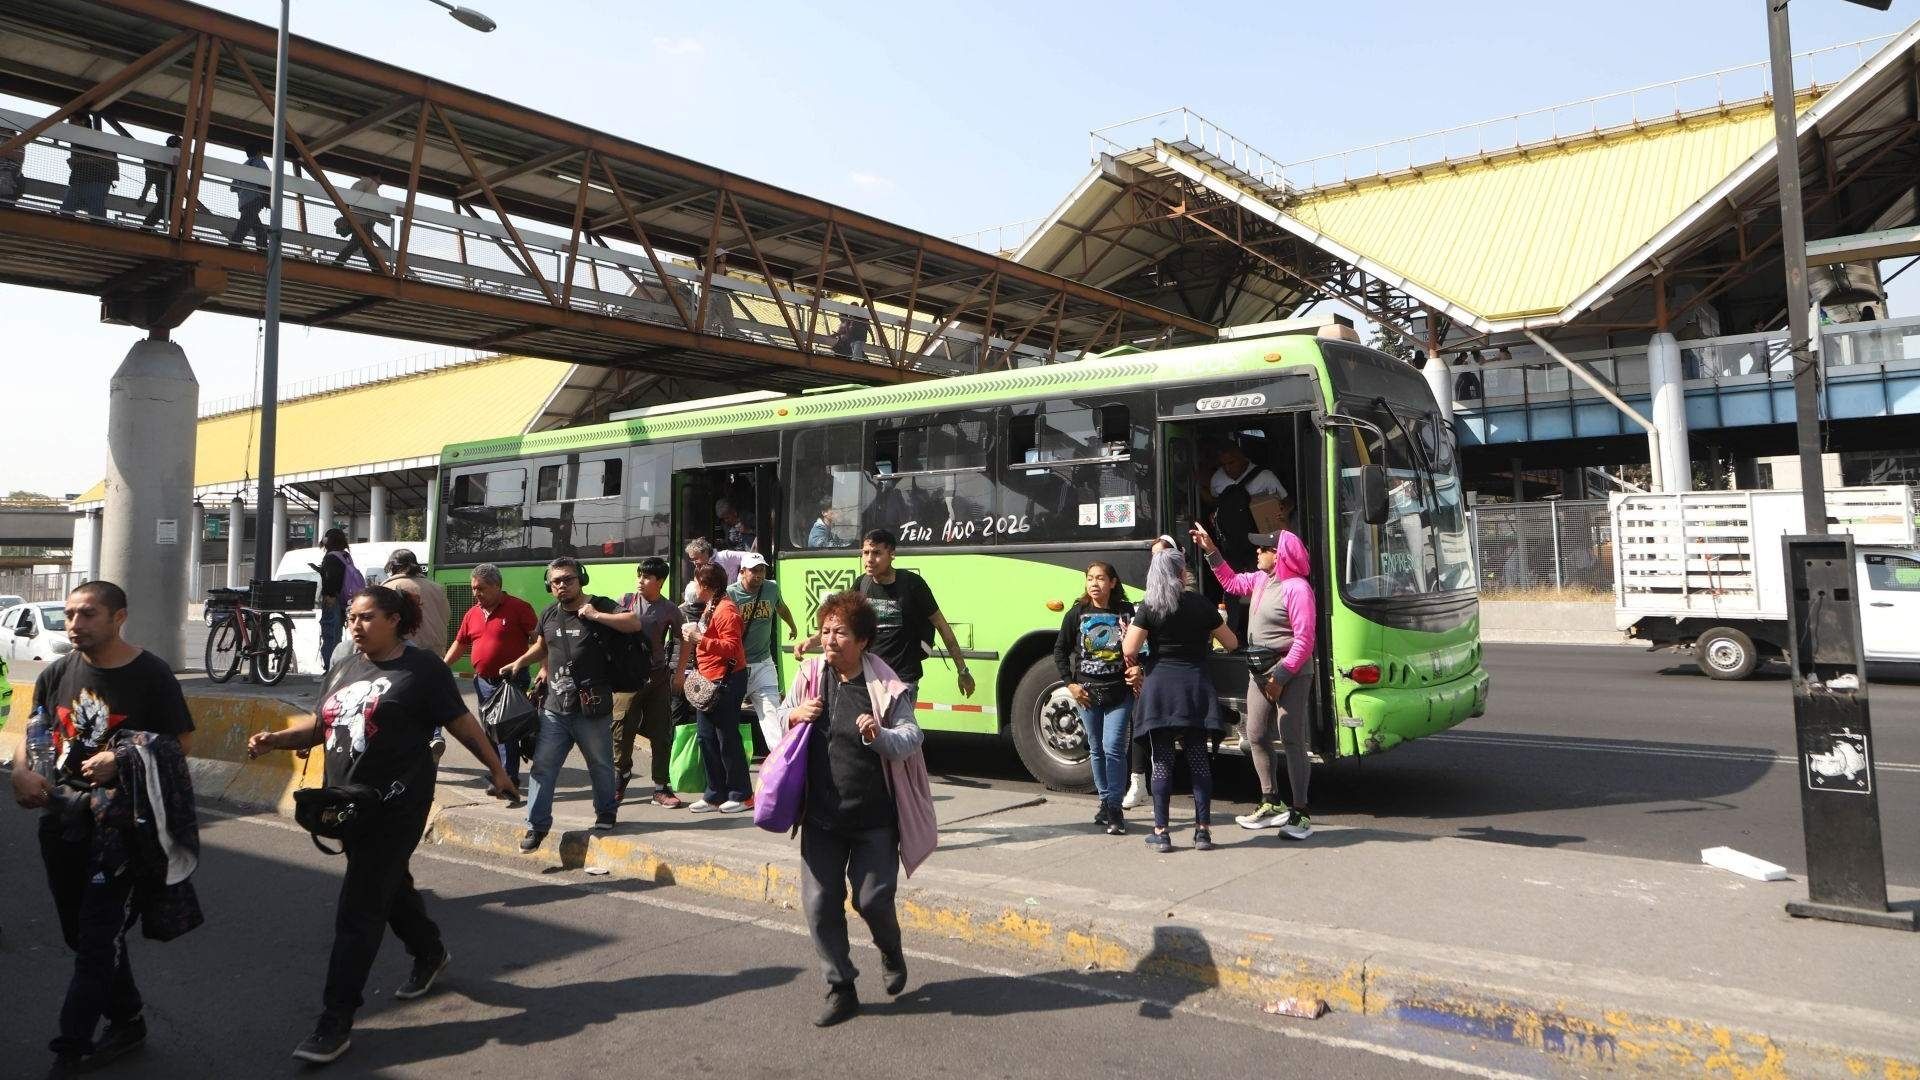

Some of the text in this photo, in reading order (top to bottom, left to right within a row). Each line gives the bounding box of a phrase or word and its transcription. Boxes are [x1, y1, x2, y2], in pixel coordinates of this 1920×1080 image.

[1201, 395, 1262, 410] Torino
[942, 518, 975, 542] AÑO
[983, 514, 1031, 537] 2026
